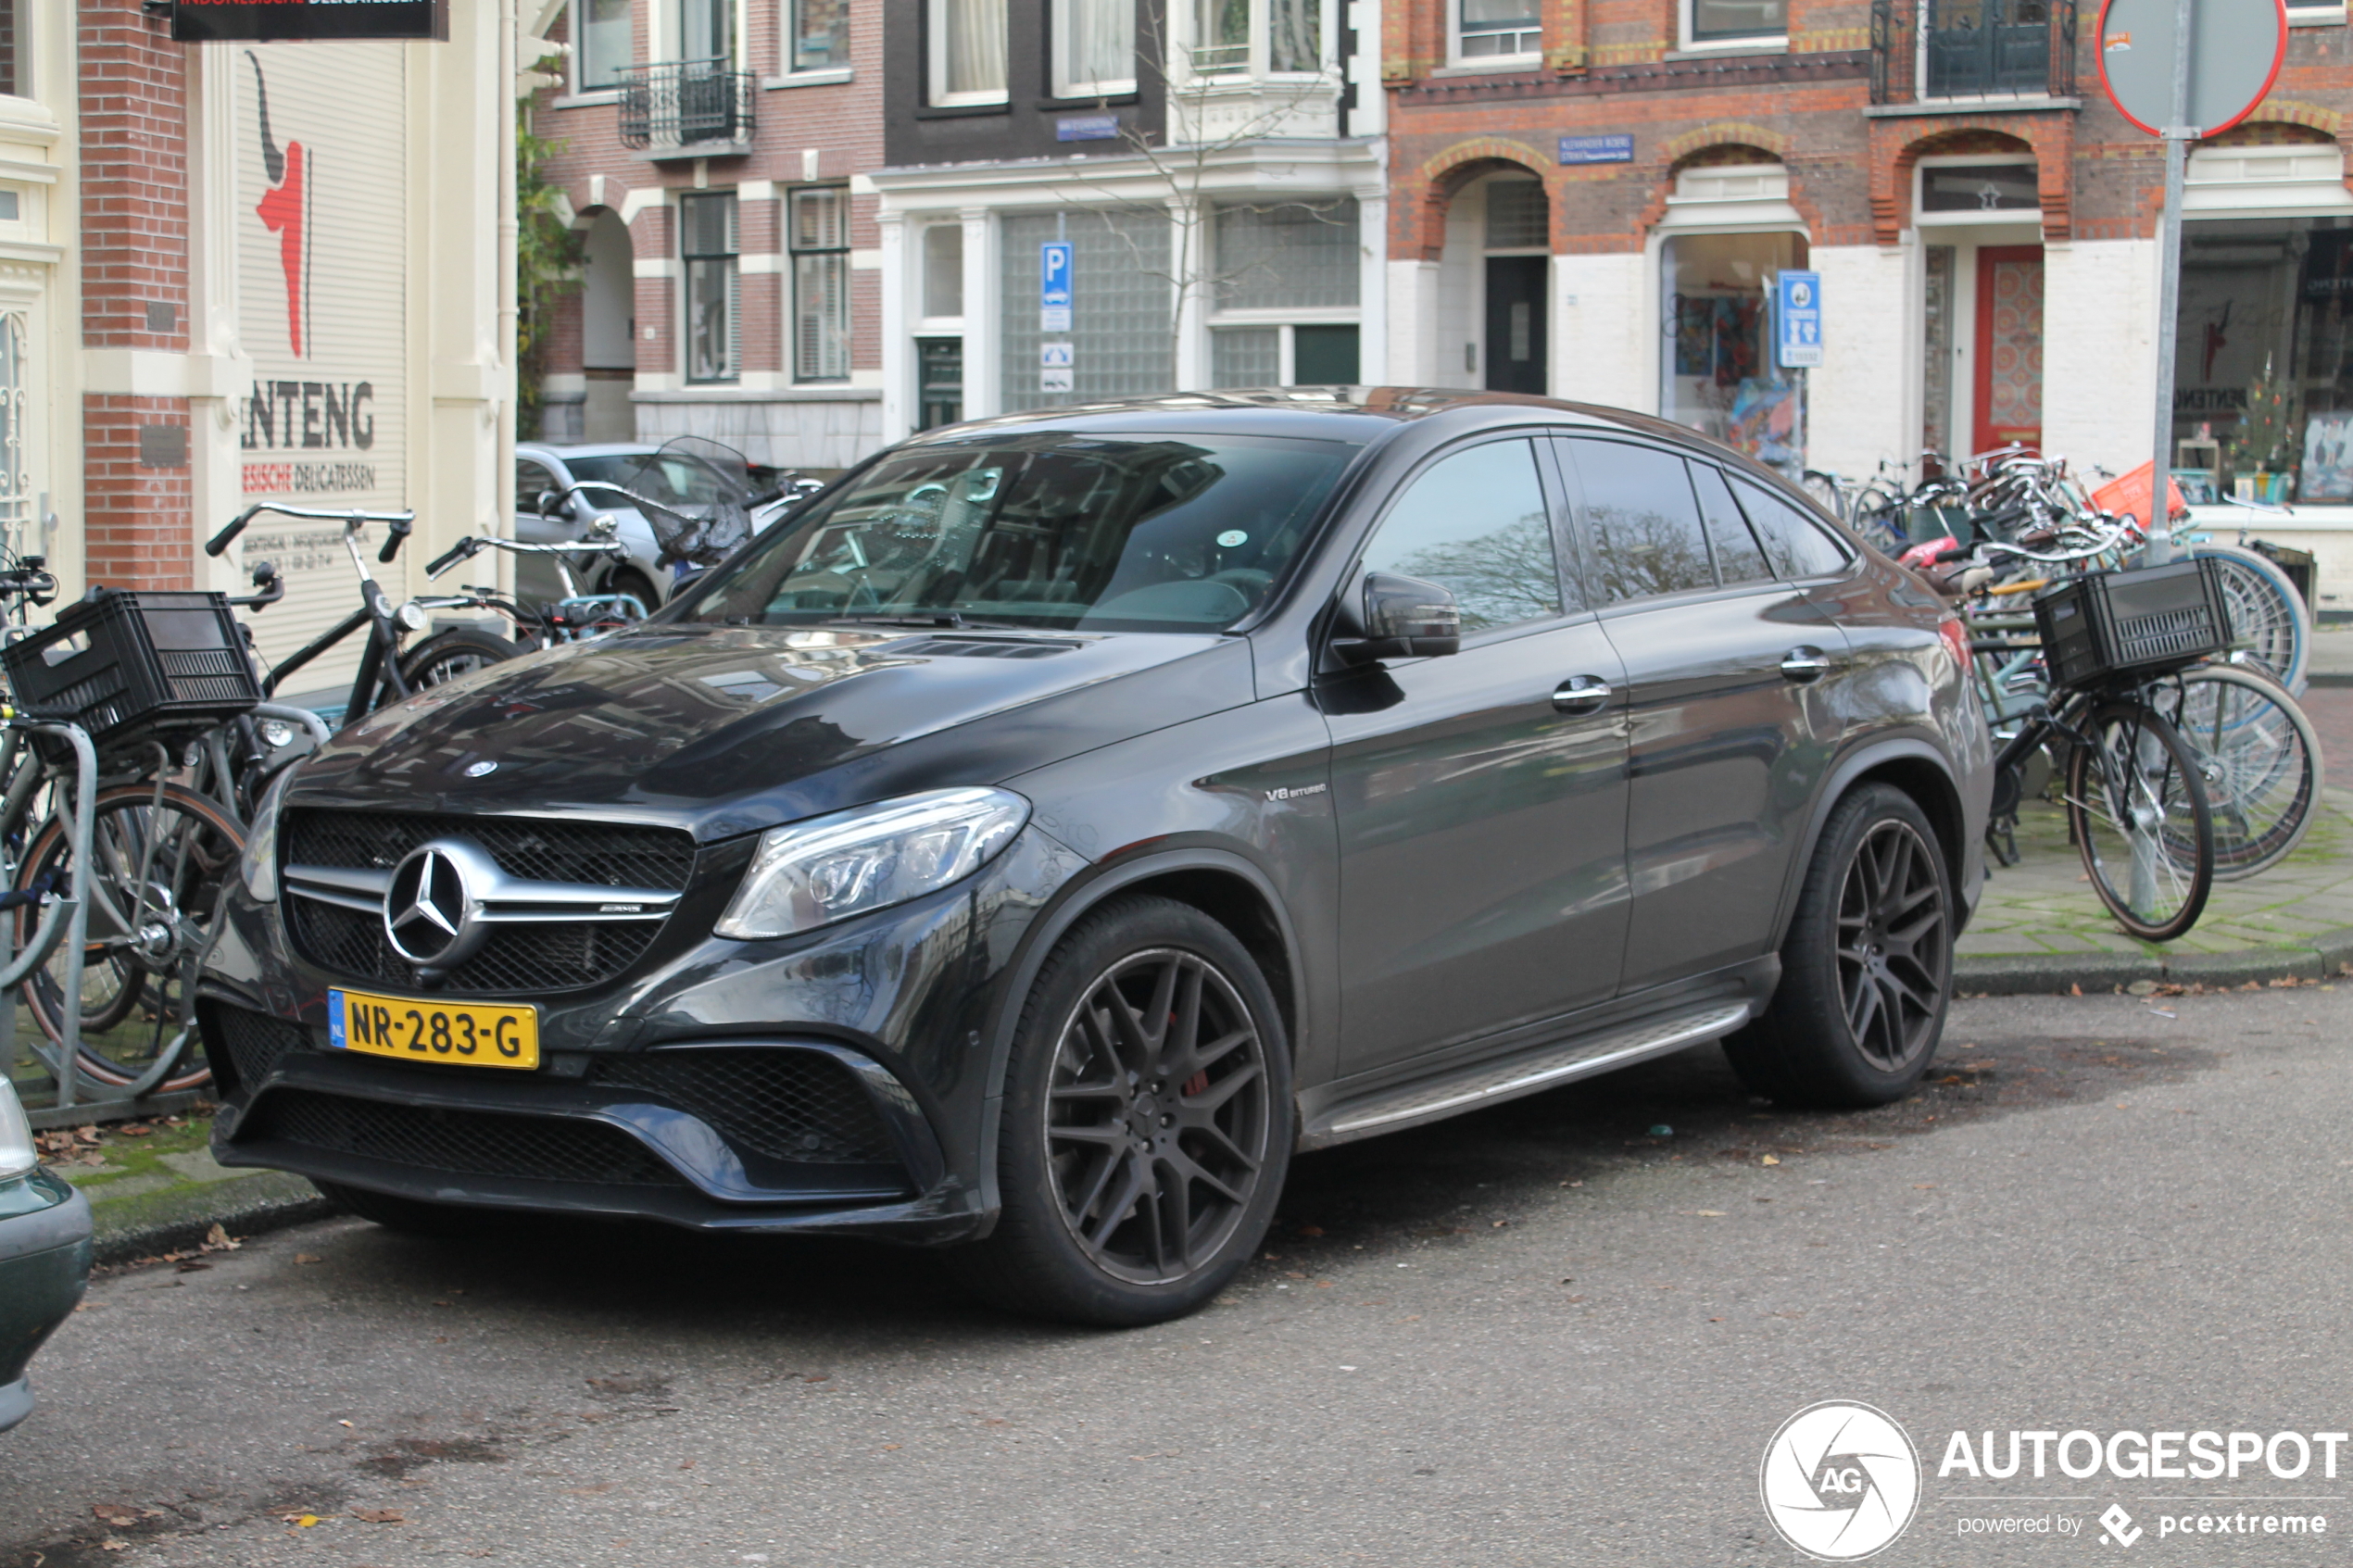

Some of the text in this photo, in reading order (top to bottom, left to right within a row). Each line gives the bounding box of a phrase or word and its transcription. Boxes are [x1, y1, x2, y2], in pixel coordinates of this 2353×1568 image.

[1047, 248, 1065, 282] P
[295, 464, 375, 492] DELICATESSEN
[1265, 783, 1327, 802] V8 BITURBO
[332, 1024, 345, 1038] NL
[351, 1002, 521, 1058] NR-283-G
